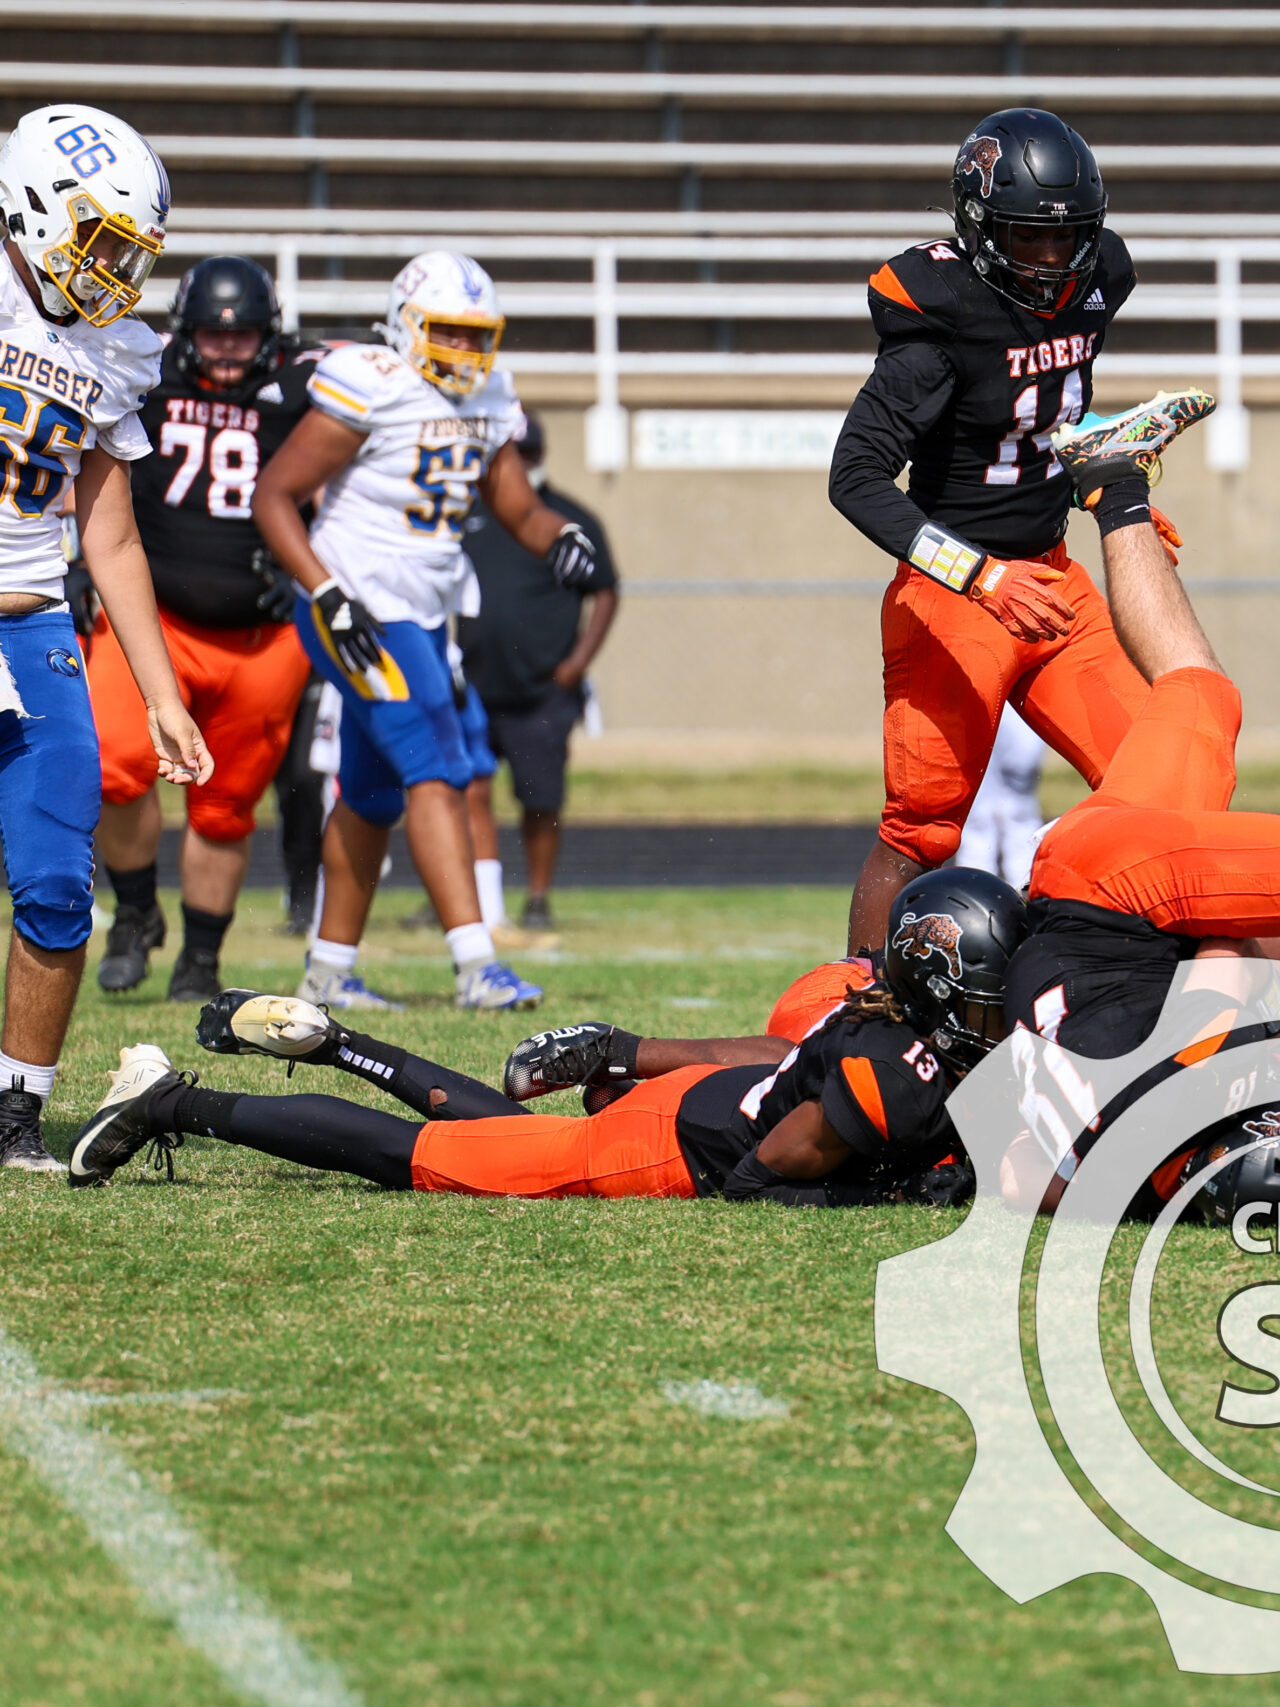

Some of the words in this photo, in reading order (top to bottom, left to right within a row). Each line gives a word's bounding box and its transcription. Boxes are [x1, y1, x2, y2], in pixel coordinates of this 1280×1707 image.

[54, 123, 117, 179] 66
[1083, 302, 1106, 311] adidas
[1007, 332, 1099, 378] TIGERS
[0, 339, 104, 422] ROSSER
[166, 398, 261, 431] TIGERS
[160, 421, 260, 519] 78
[902, 1040, 940, 1082] 13
